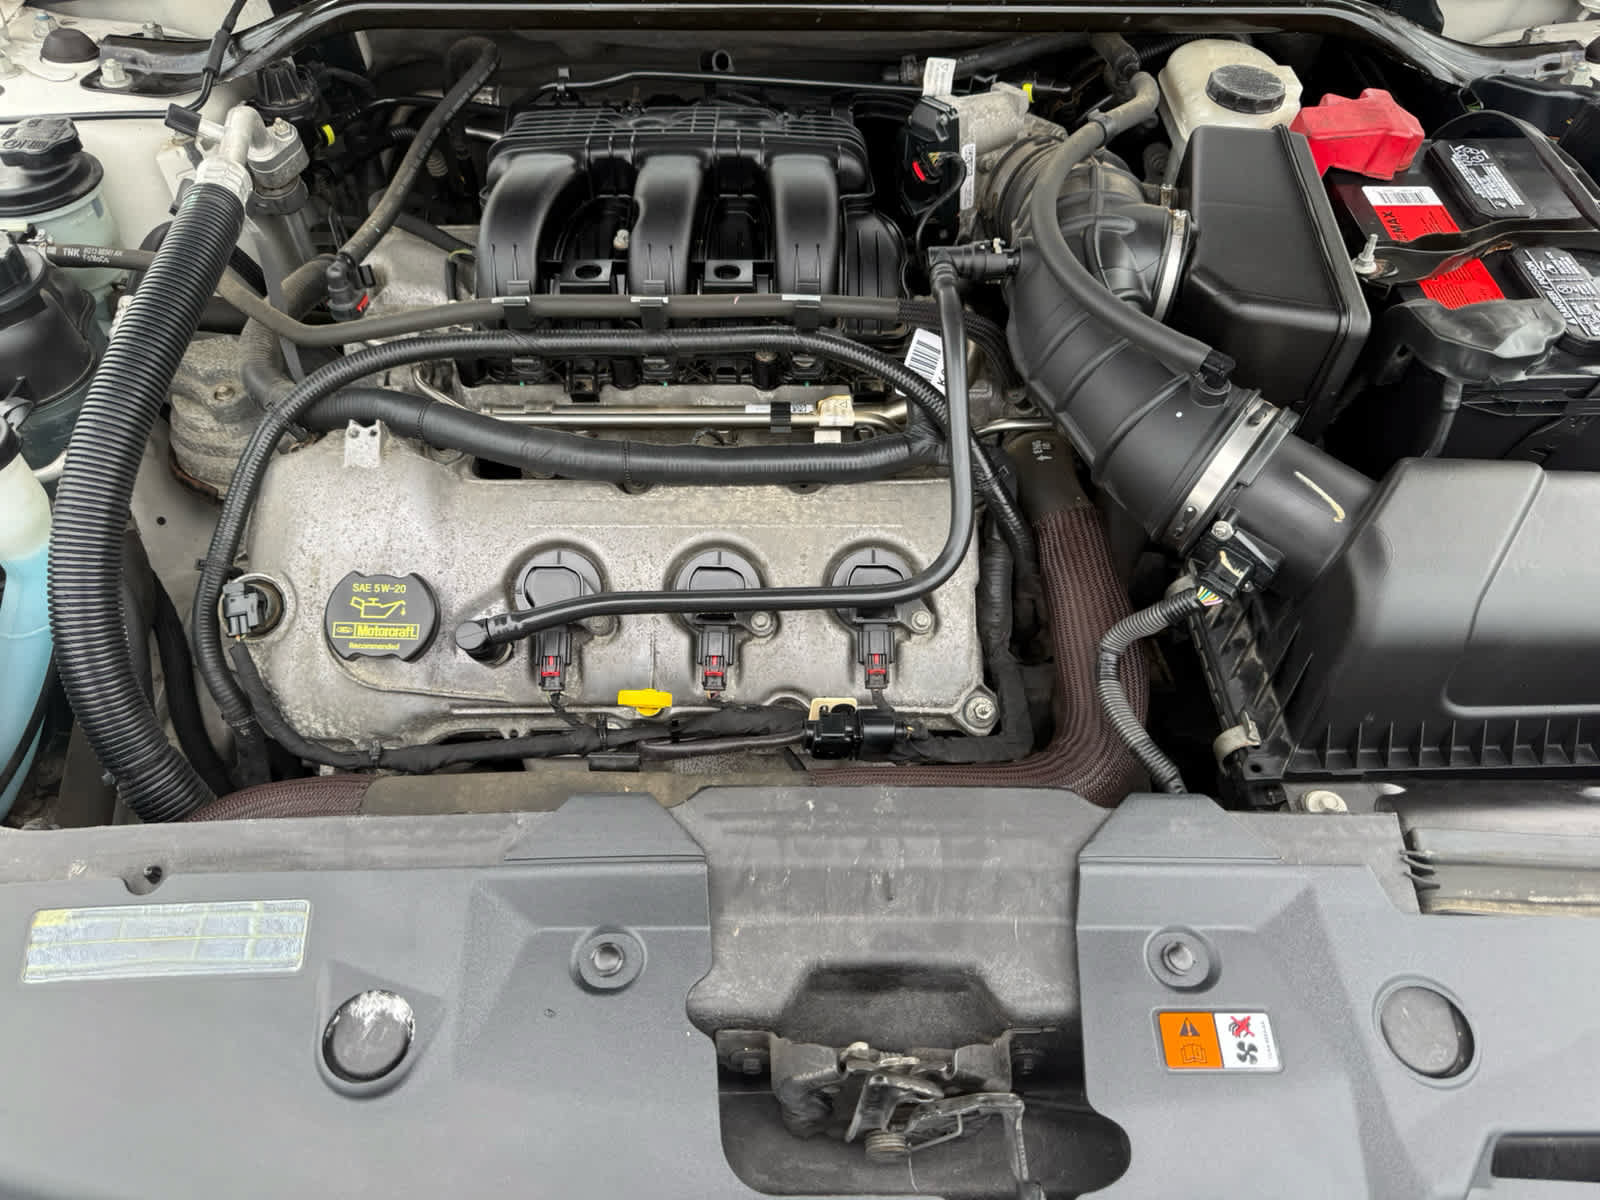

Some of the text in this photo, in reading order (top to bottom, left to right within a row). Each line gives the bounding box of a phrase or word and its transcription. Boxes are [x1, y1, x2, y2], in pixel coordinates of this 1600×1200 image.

[1524, 261, 1549, 286] POISON
[352, 582, 406, 593] SAE 5W-20
[357, 624, 417, 638] Motorcraft
